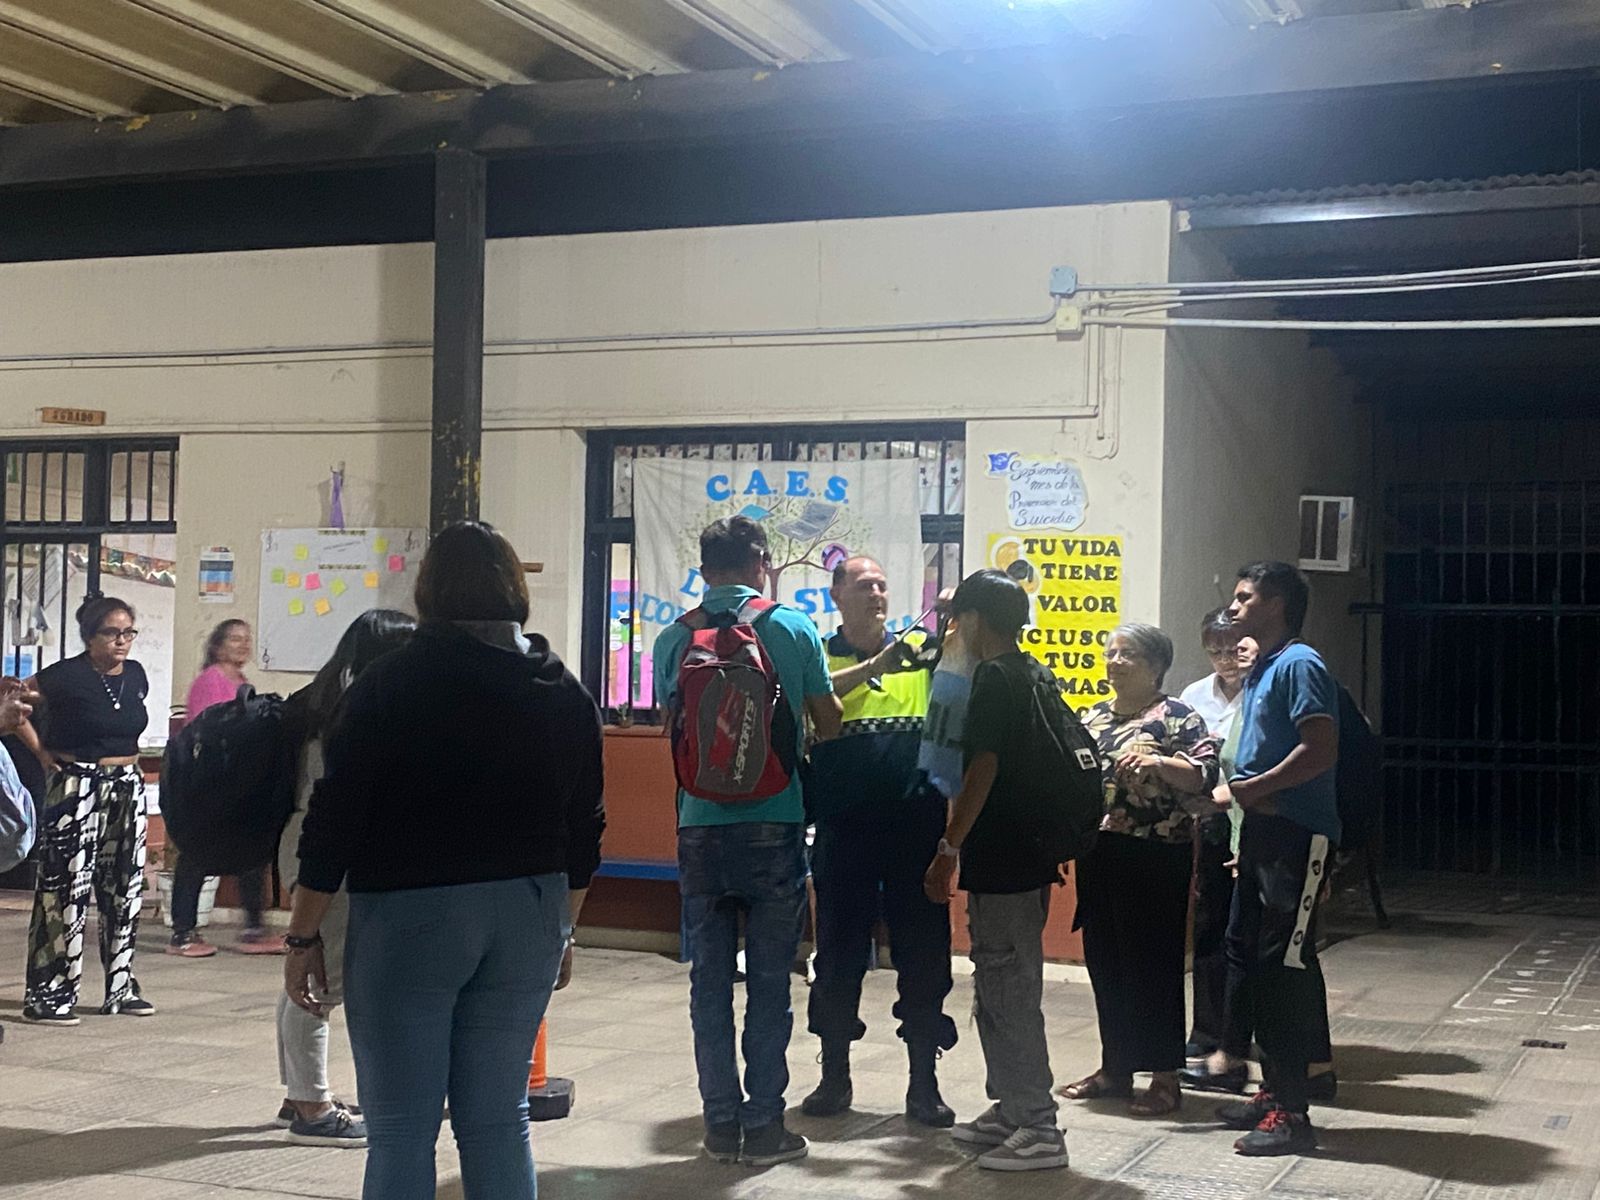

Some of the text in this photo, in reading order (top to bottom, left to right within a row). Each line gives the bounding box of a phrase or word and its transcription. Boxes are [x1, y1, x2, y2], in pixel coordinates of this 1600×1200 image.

[1023, 538, 1121, 557] TU VIDA
[1041, 563, 1118, 580] TIENE
[1037, 595, 1117, 613] VALOR
[1045, 652, 1095, 669] TUS
[1057, 677, 1110, 695] MAS
